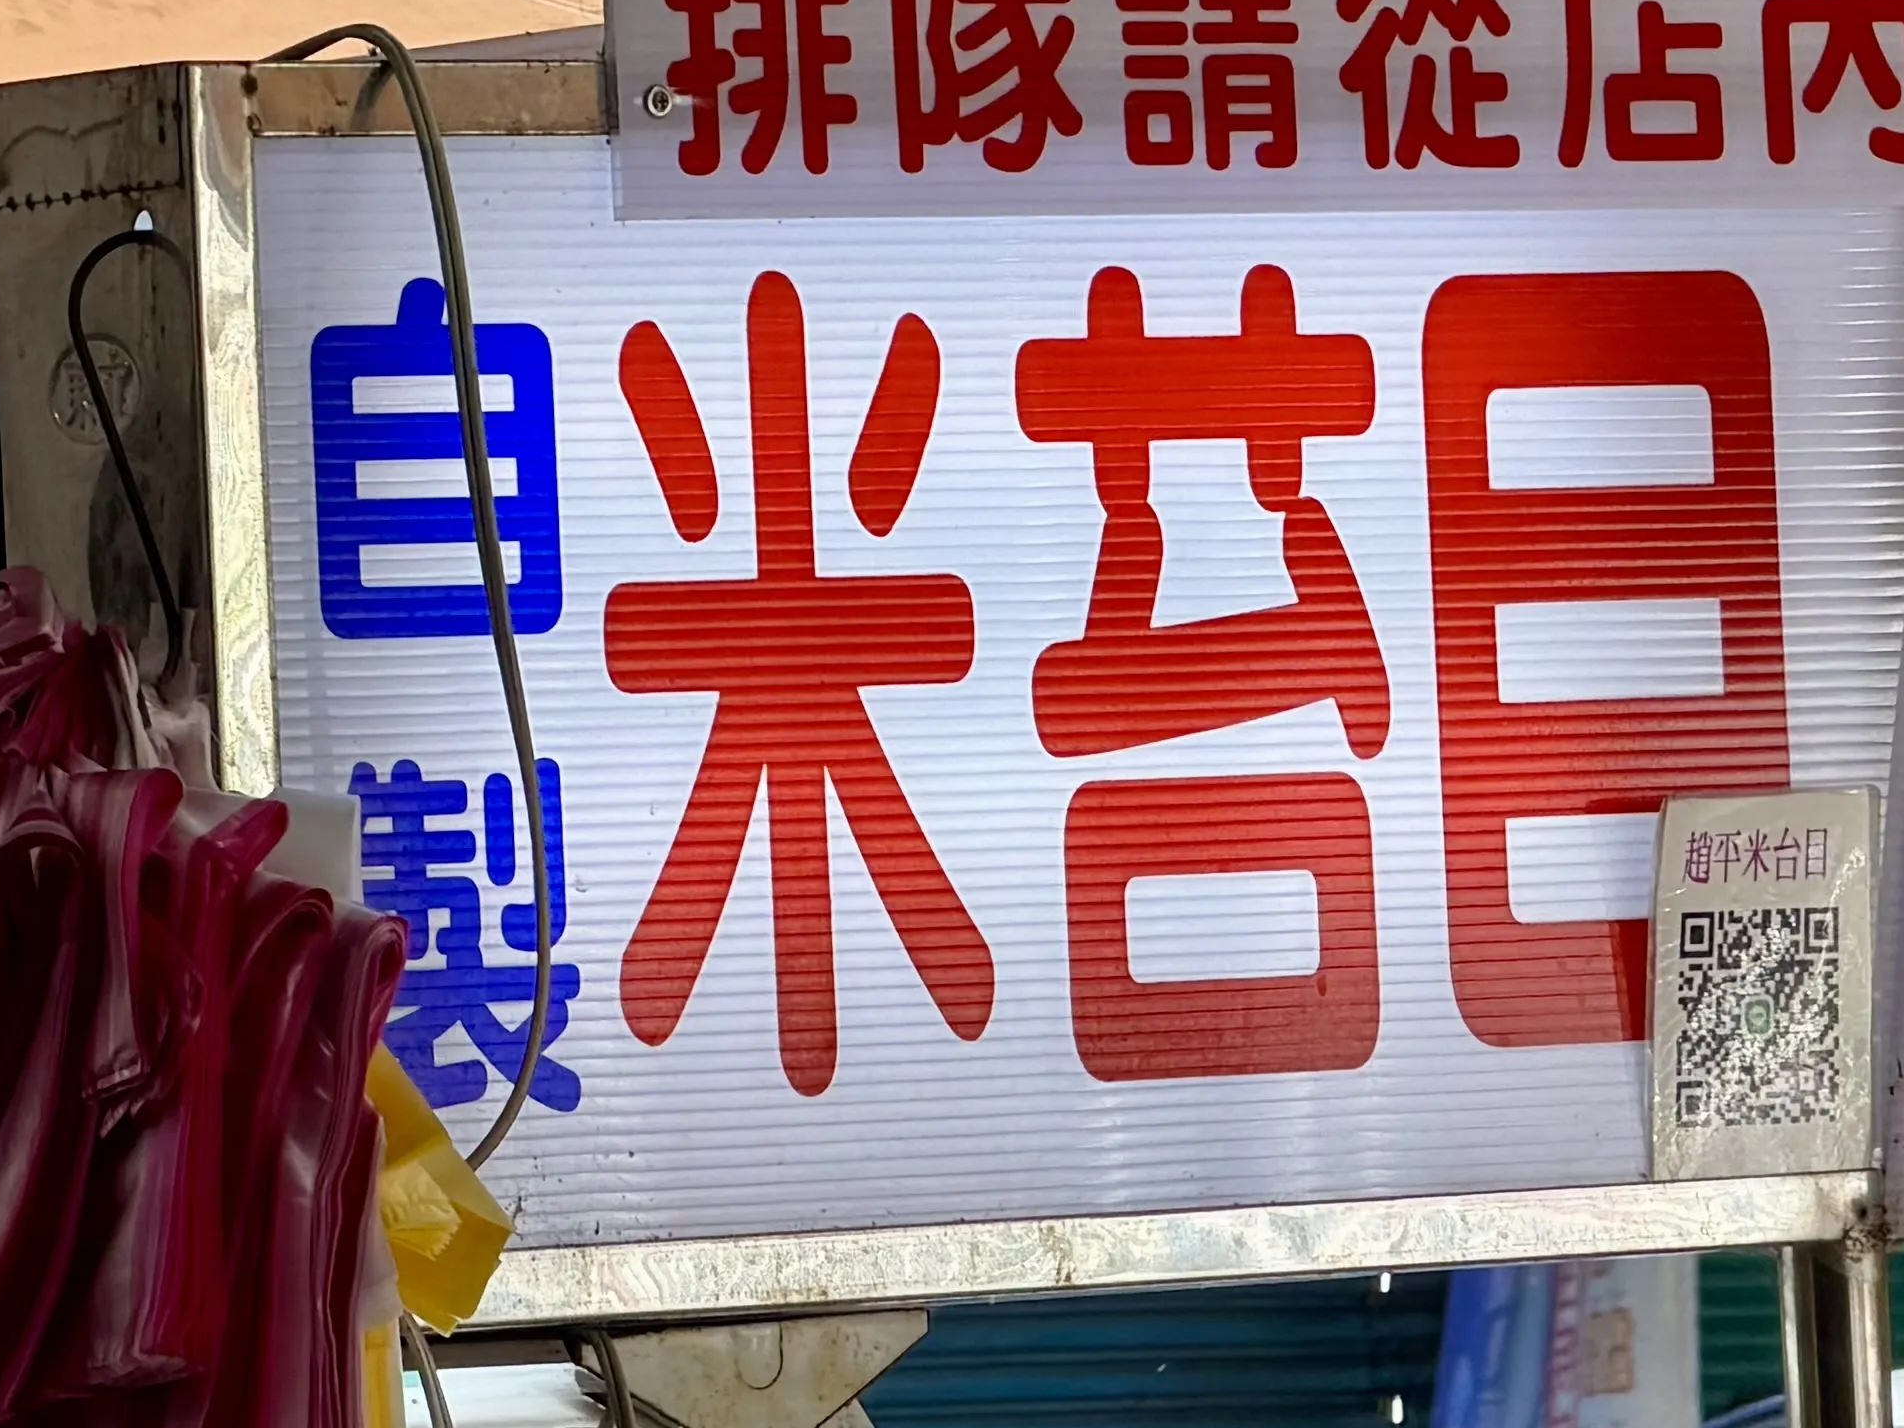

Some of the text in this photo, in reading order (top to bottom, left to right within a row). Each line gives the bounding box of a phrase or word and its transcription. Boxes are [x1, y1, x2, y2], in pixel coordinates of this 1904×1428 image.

[309, 277, 583, 1115] 自製
[603, 262, 1792, 1098] 米苔目
[1682, 826, 1829, 885] 趙平米台目
